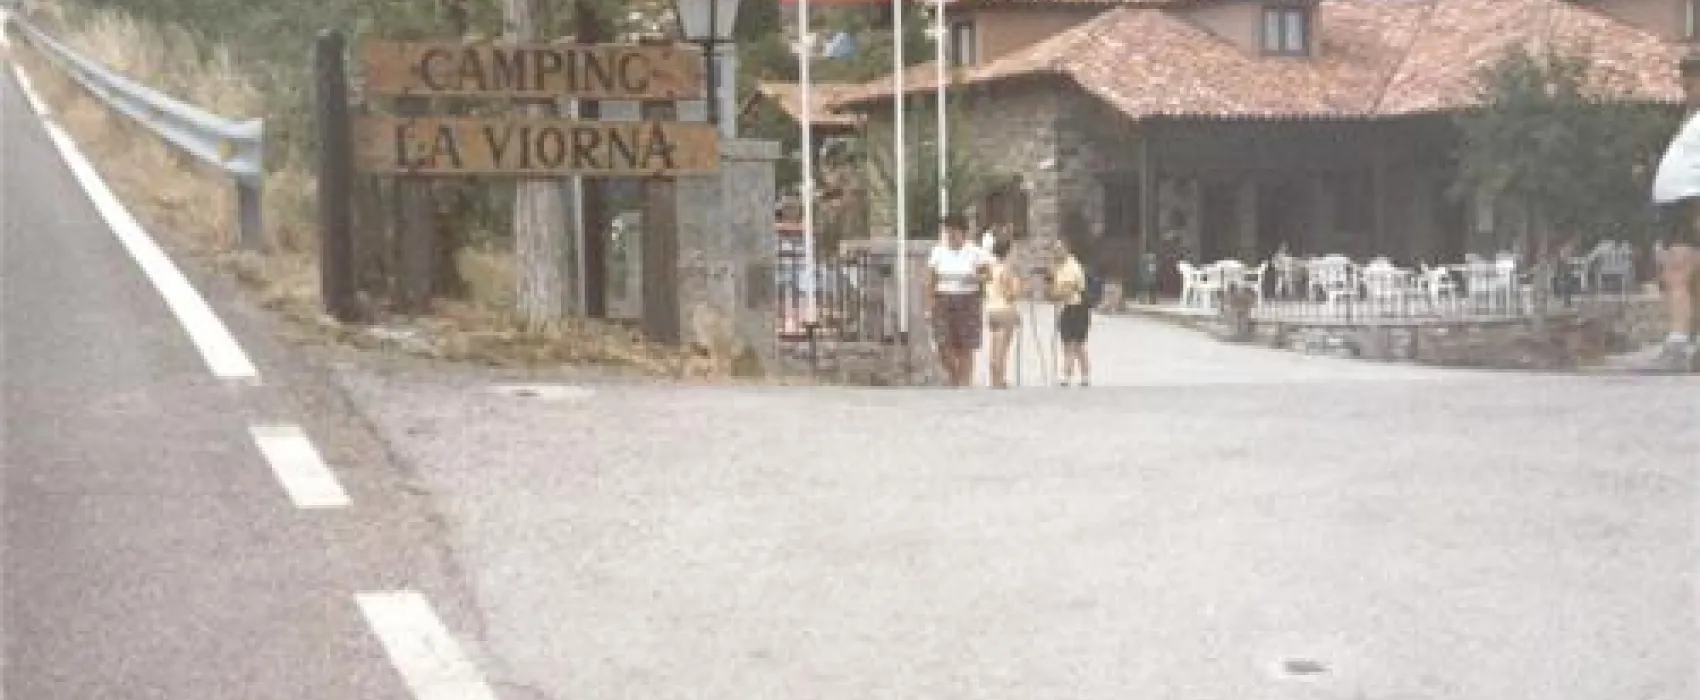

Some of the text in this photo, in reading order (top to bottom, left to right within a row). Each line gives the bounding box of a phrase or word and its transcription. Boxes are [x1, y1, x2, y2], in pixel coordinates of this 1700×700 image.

[420, 48, 650, 94] CAMPING
[395, 124, 677, 170] LA VIORNA
